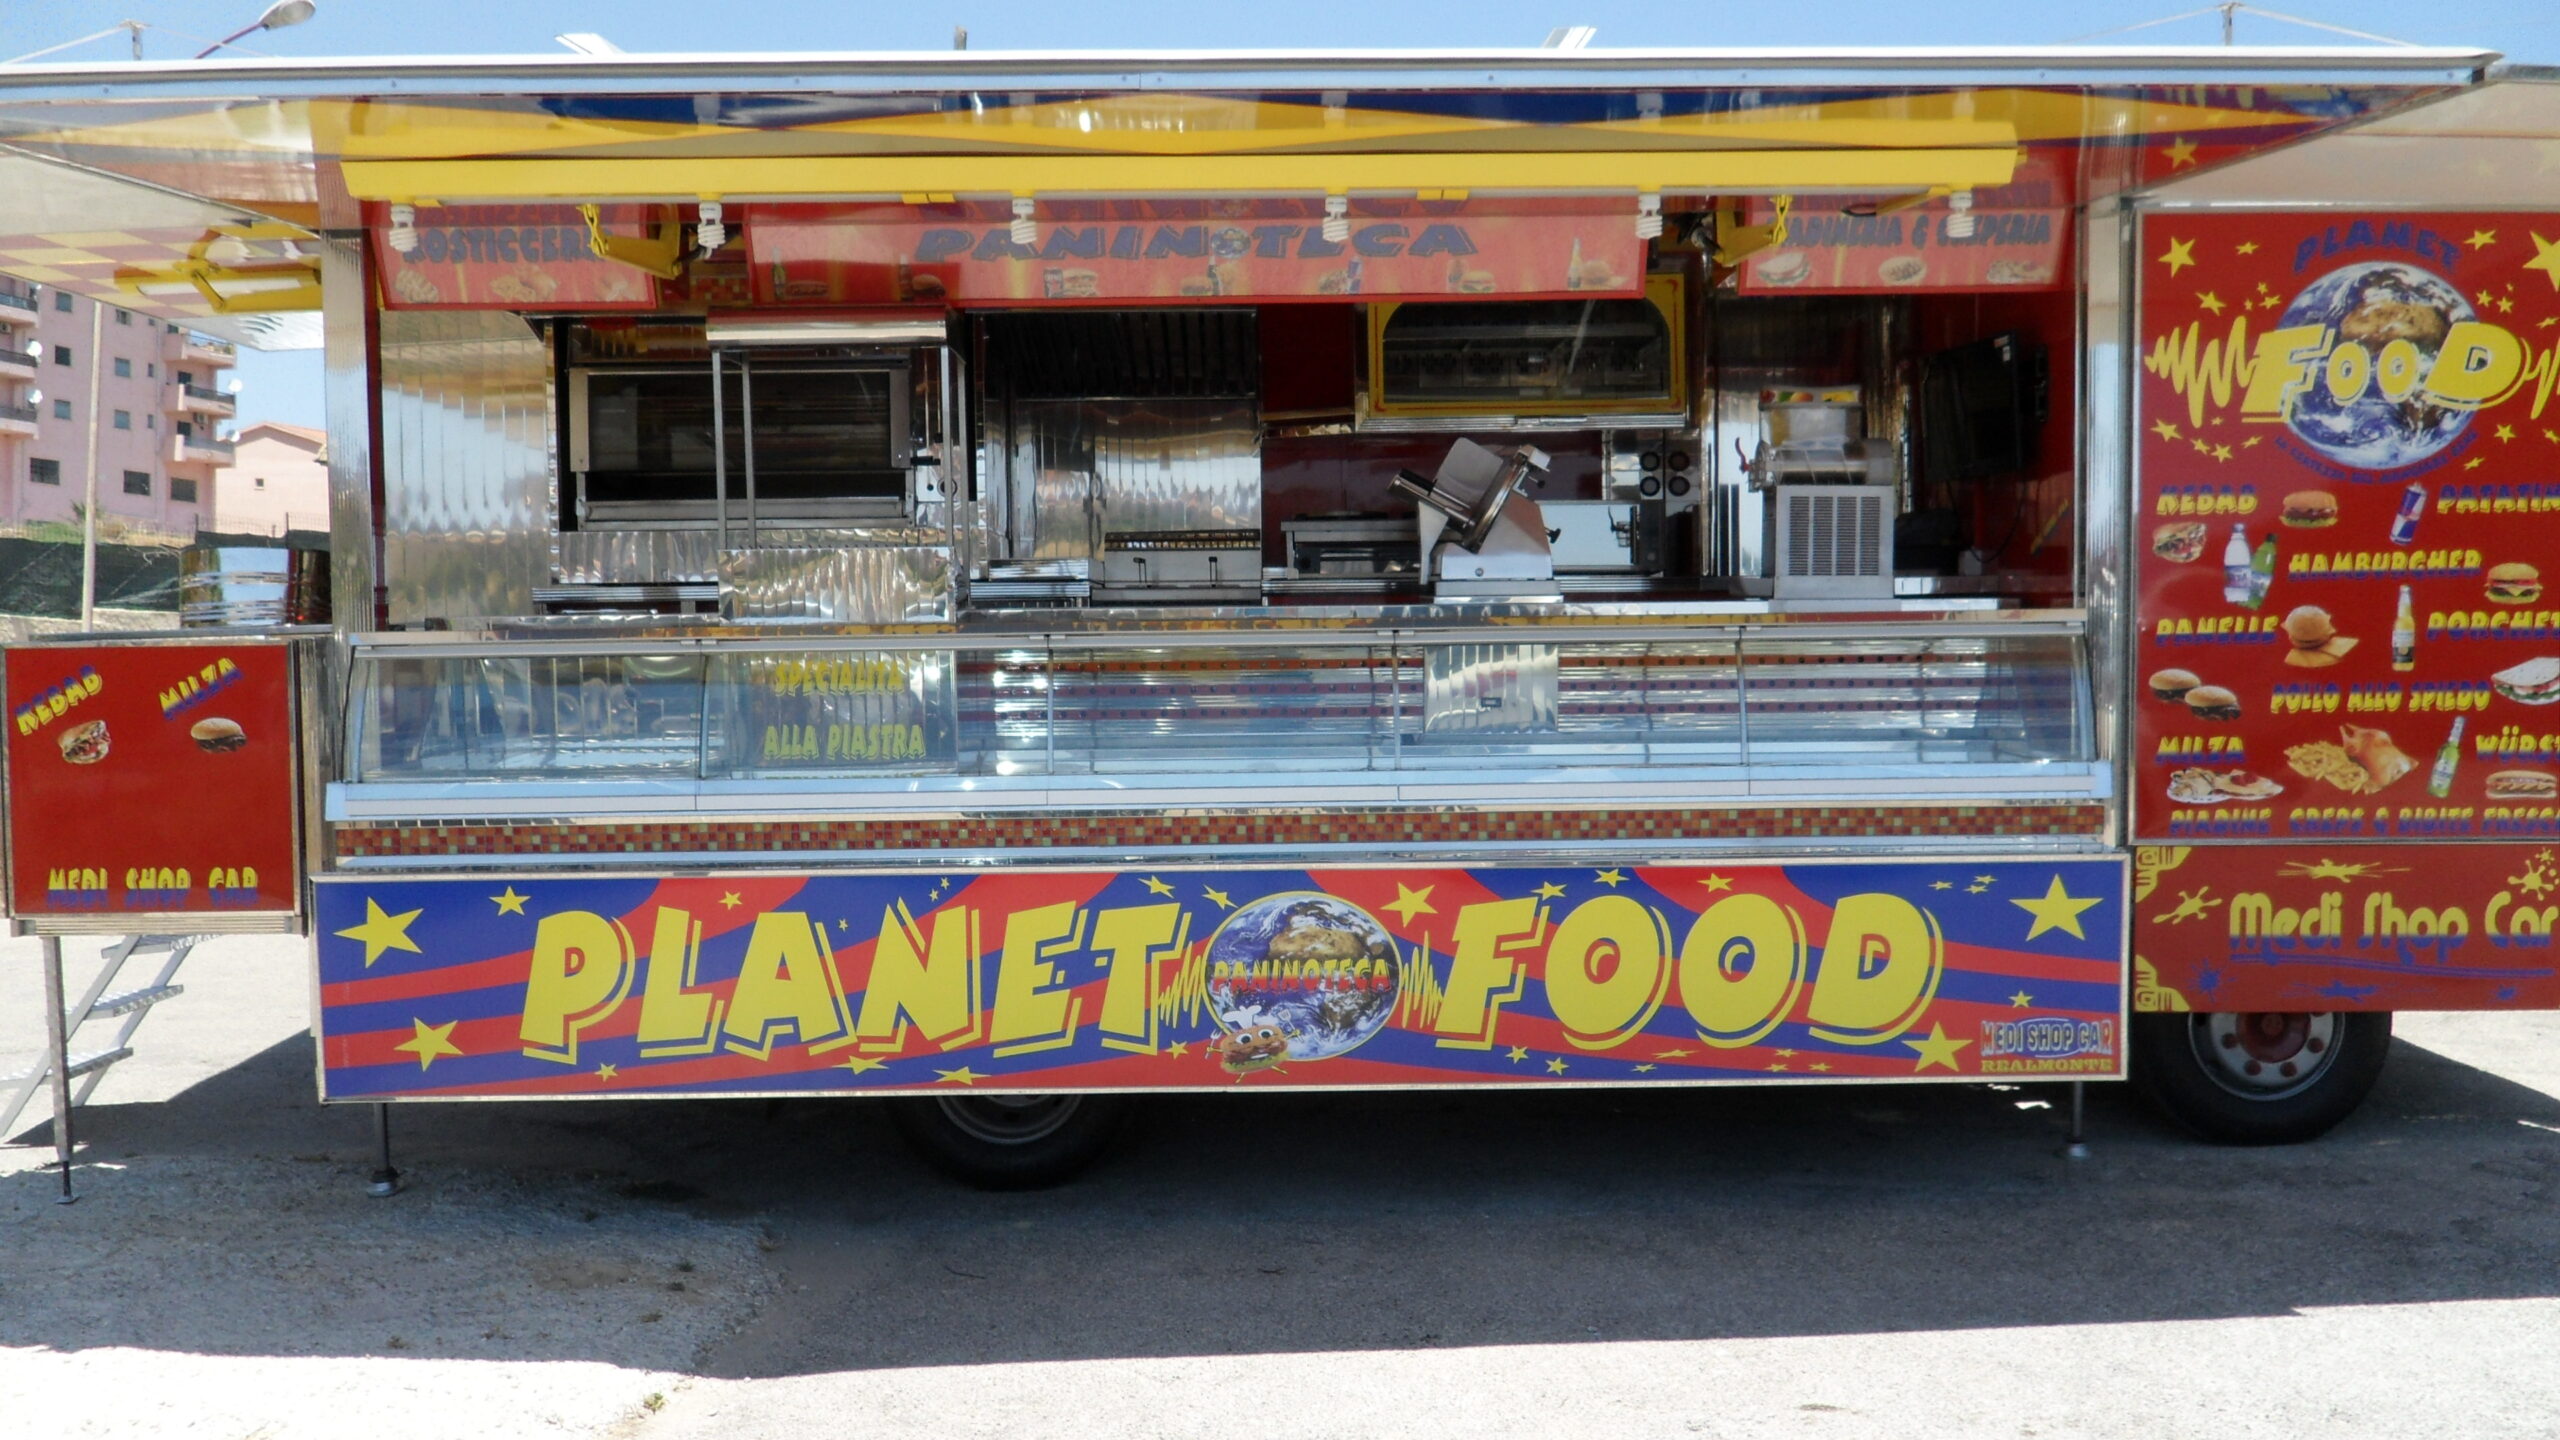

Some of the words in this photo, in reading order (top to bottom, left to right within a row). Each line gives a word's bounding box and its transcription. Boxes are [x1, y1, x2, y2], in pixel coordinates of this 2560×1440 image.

[401, 226, 613, 264] OSTICCER
[1767, 215, 1903, 247] ADINERIA
[2292, 219, 2464, 274] PLANET
[2240, 321, 2531, 424] FOOD
[2155, 484, 2259, 515] KEBAB
[2155, 615, 2280, 646] PANELLE
[14, 664, 104, 737] KEBAB
[159, 656, 244, 722] MILZA
[2270, 682, 2341, 714] POLLO
[2347, 681, 2402, 713] ALLO
[2409, 680, 2491, 713] SPIEDO
[764, 724, 820, 760] ALLA
[827, 723, 926, 760] PIASTRA
[2155, 736, 2247, 764] MILZA
[519, 896, 1193, 1066] PLANET
[1211, 957, 1393, 994] PANINOTECA
[1435, 892, 1944, 1052] FOOD
[1981, 1020, 2023, 1057] MEDI
[2026, 1022, 2074, 1052] SHOP
[2077, 1018, 2113, 1055] CAR
[1981, 1058, 2113, 1073] REALMONTE
